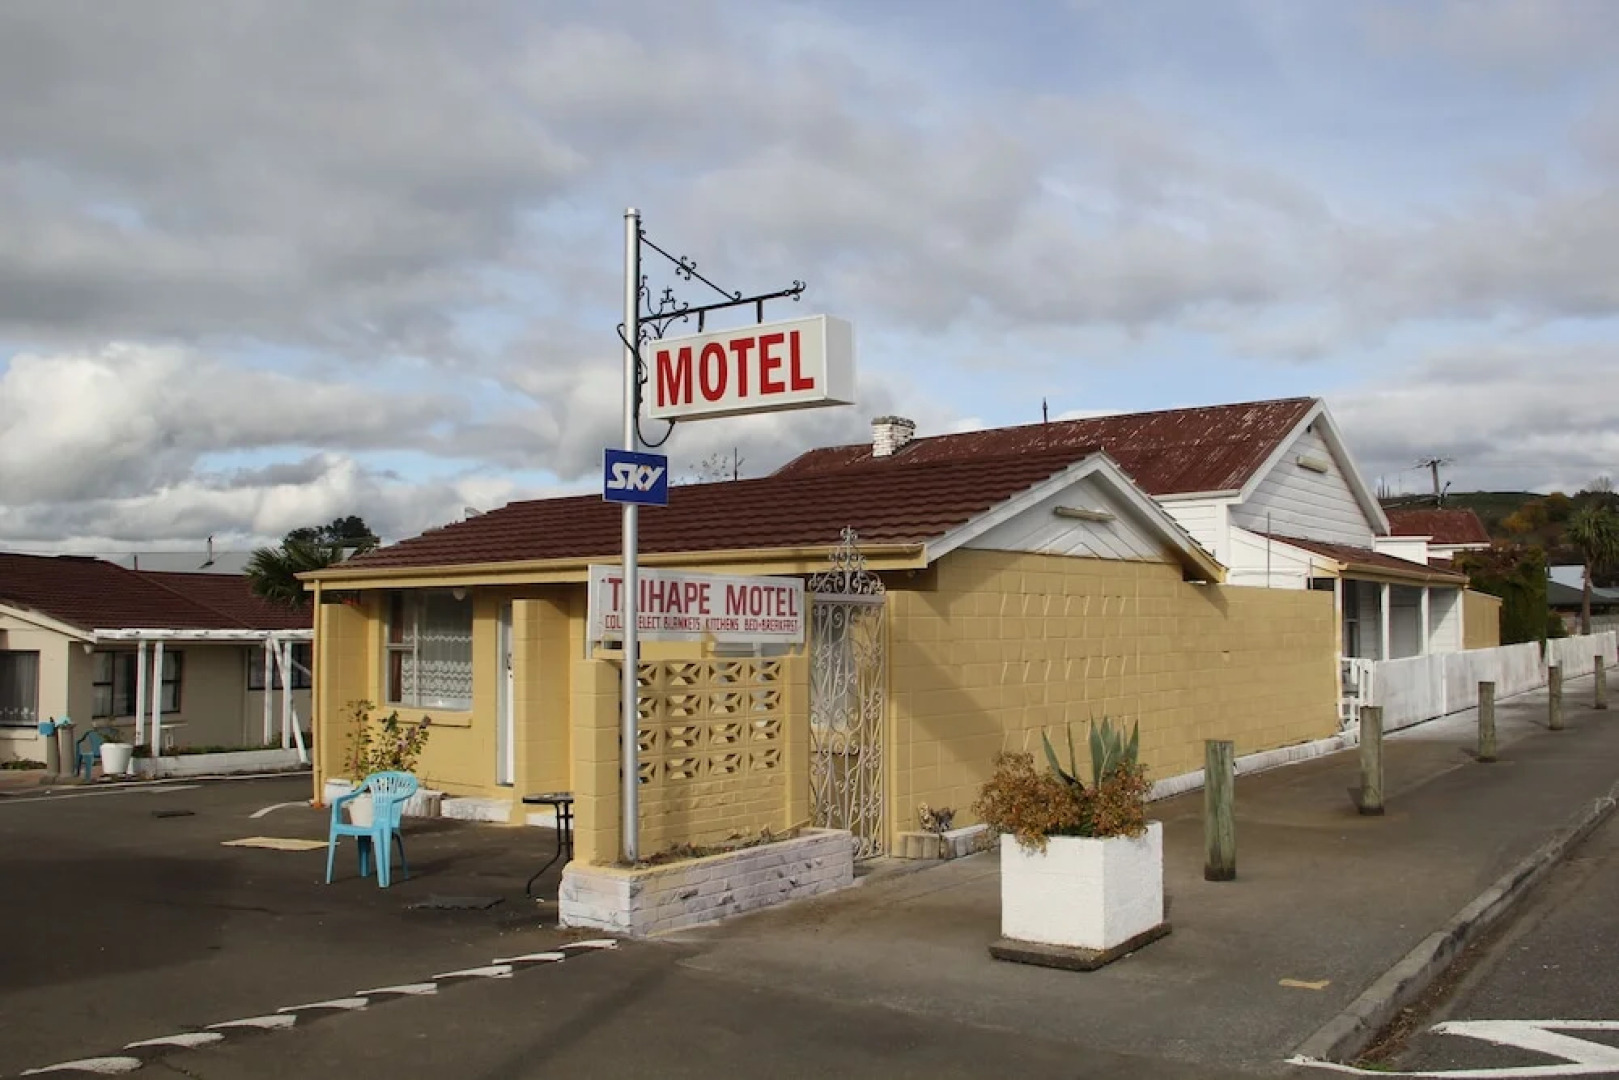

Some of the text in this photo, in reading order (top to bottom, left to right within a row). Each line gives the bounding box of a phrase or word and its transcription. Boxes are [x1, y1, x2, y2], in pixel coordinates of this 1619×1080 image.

[656, 330, 815, 407] MOTEL
[606, 462, 665, 491] SKY
[608, 577, 798, 617] TIHAPE MOTEL
[705, 618, 739, 631] KITCHENS
